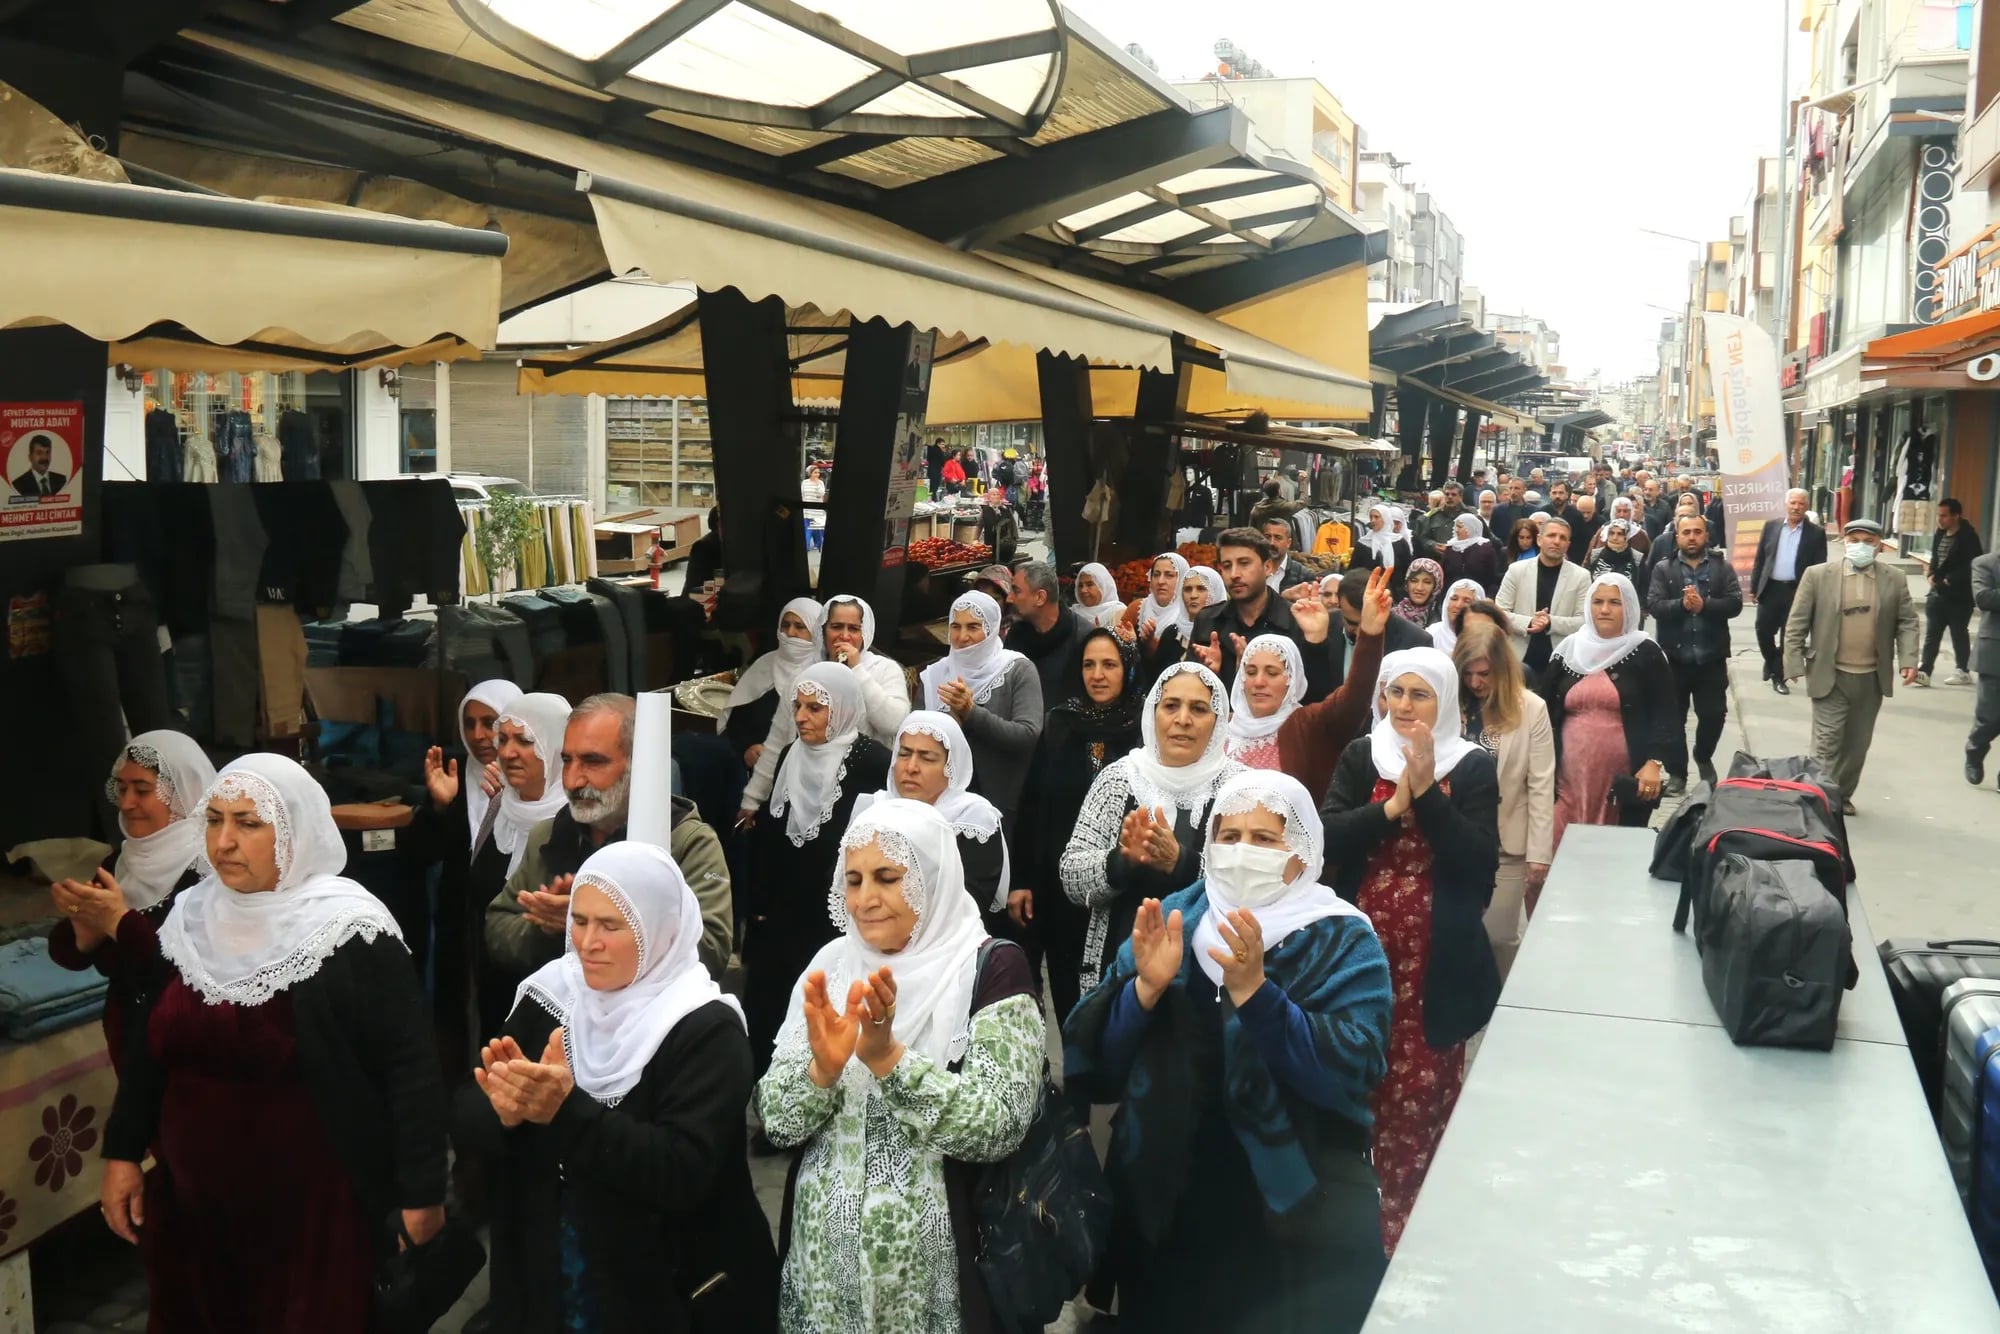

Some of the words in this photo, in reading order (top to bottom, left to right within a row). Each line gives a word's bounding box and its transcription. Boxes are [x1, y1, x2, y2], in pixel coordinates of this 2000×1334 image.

[11, 418, 45, 428] MUHTAR
[46, 417, 70, 427] ADAYI
[2, 512, 35, 524] MEHMET
